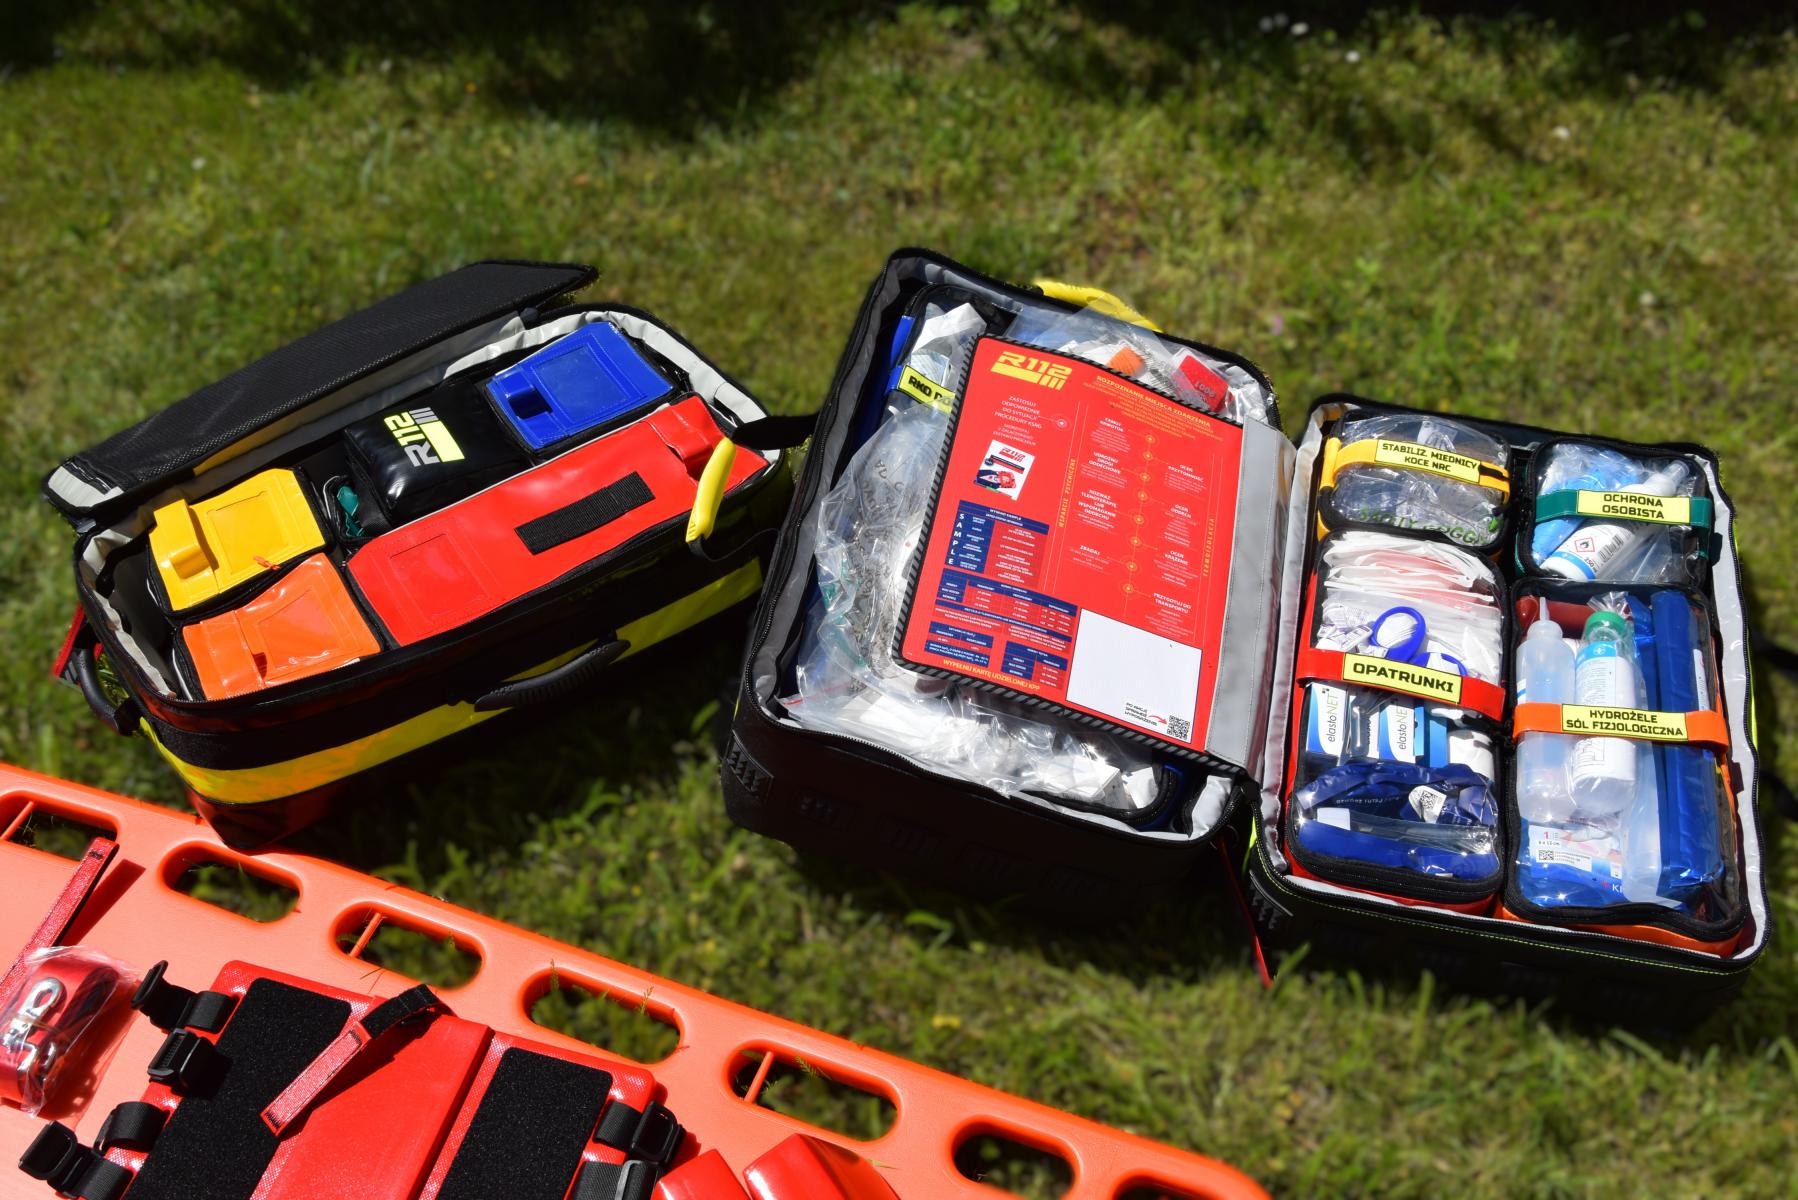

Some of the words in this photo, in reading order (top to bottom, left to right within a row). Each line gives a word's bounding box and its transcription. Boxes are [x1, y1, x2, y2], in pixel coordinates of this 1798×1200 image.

[999, 351, 1073, 378] R112
[908, 375, 933, 398] RKO
[1008, 395, 1038, 408] ZASTOSUJ
[1096, 375, 1144, 401] ROZPOZNANIE
[1145, 396, 1172, 413] MIEJSCA
[1173, 406, 1212, 428] ZDARZENIA
[384, 411, 440, 467] R112
[1382, 443, 1428, 457] STABILIZ.
[1430, 451, 1477, 470] MIEDNICY
[1404, 456, 1429, 467] KOCE
[1431, 462, 1451, 472] NRC
[1602, 504, 1665, 519] OSOBISTA
[1603, 493, 1664, 508] OCHRONA
[1154, 599, 1189, 614] TRANSPORTU
[943, 658, 972, 673] WYPEŁNIJ
[972, 666, 992, 679] KARTĘ
[991, 672, 1028, 689] UDZIELONEJ
[1027, 681, 1041, 691] KPP
[1353, 662, 1453, 693] OPATRUNKI
[1327, 693, 1341, 743] elastoNET
[1566, 718, 1589, 730] SÓL
[1592, 720, 1684, 737] FIZJOLOGICZNA
[1589, 709, 1658, 724] HYDROŻELE
